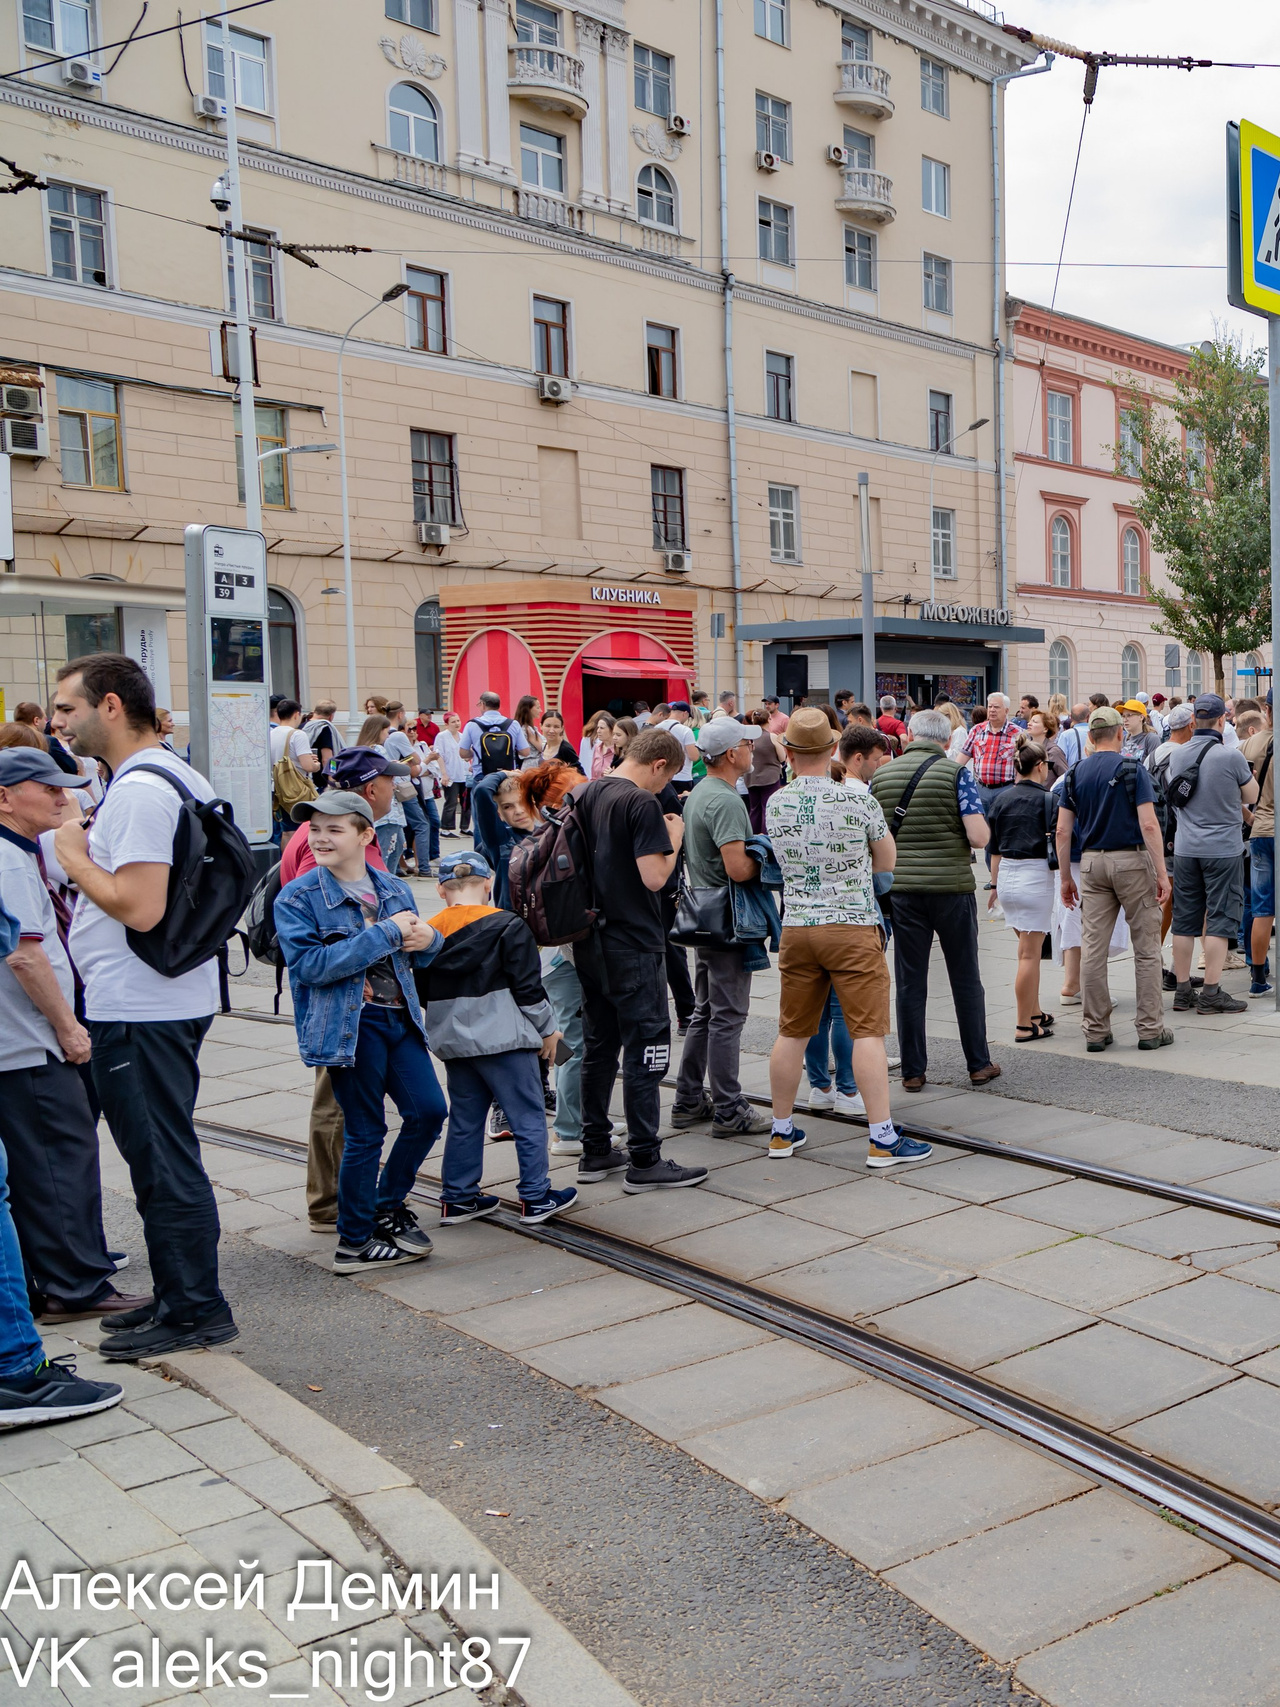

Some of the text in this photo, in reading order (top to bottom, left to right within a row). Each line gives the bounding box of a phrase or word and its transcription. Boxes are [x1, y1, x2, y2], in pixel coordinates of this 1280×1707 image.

[242, 576, 248, 586] 3
[219, 588, 230, 598] 39
[591, 586, 661, 605] КЛУБНИКА
[922, 602, 1014, 626] МОРОЖЕНОЕ
[822, 792, 867, 804] SURF
[795, 814, 815, 825] BEST
[825, 855, 864, 874] SURF
[825, 912, 866, 924] SURF
